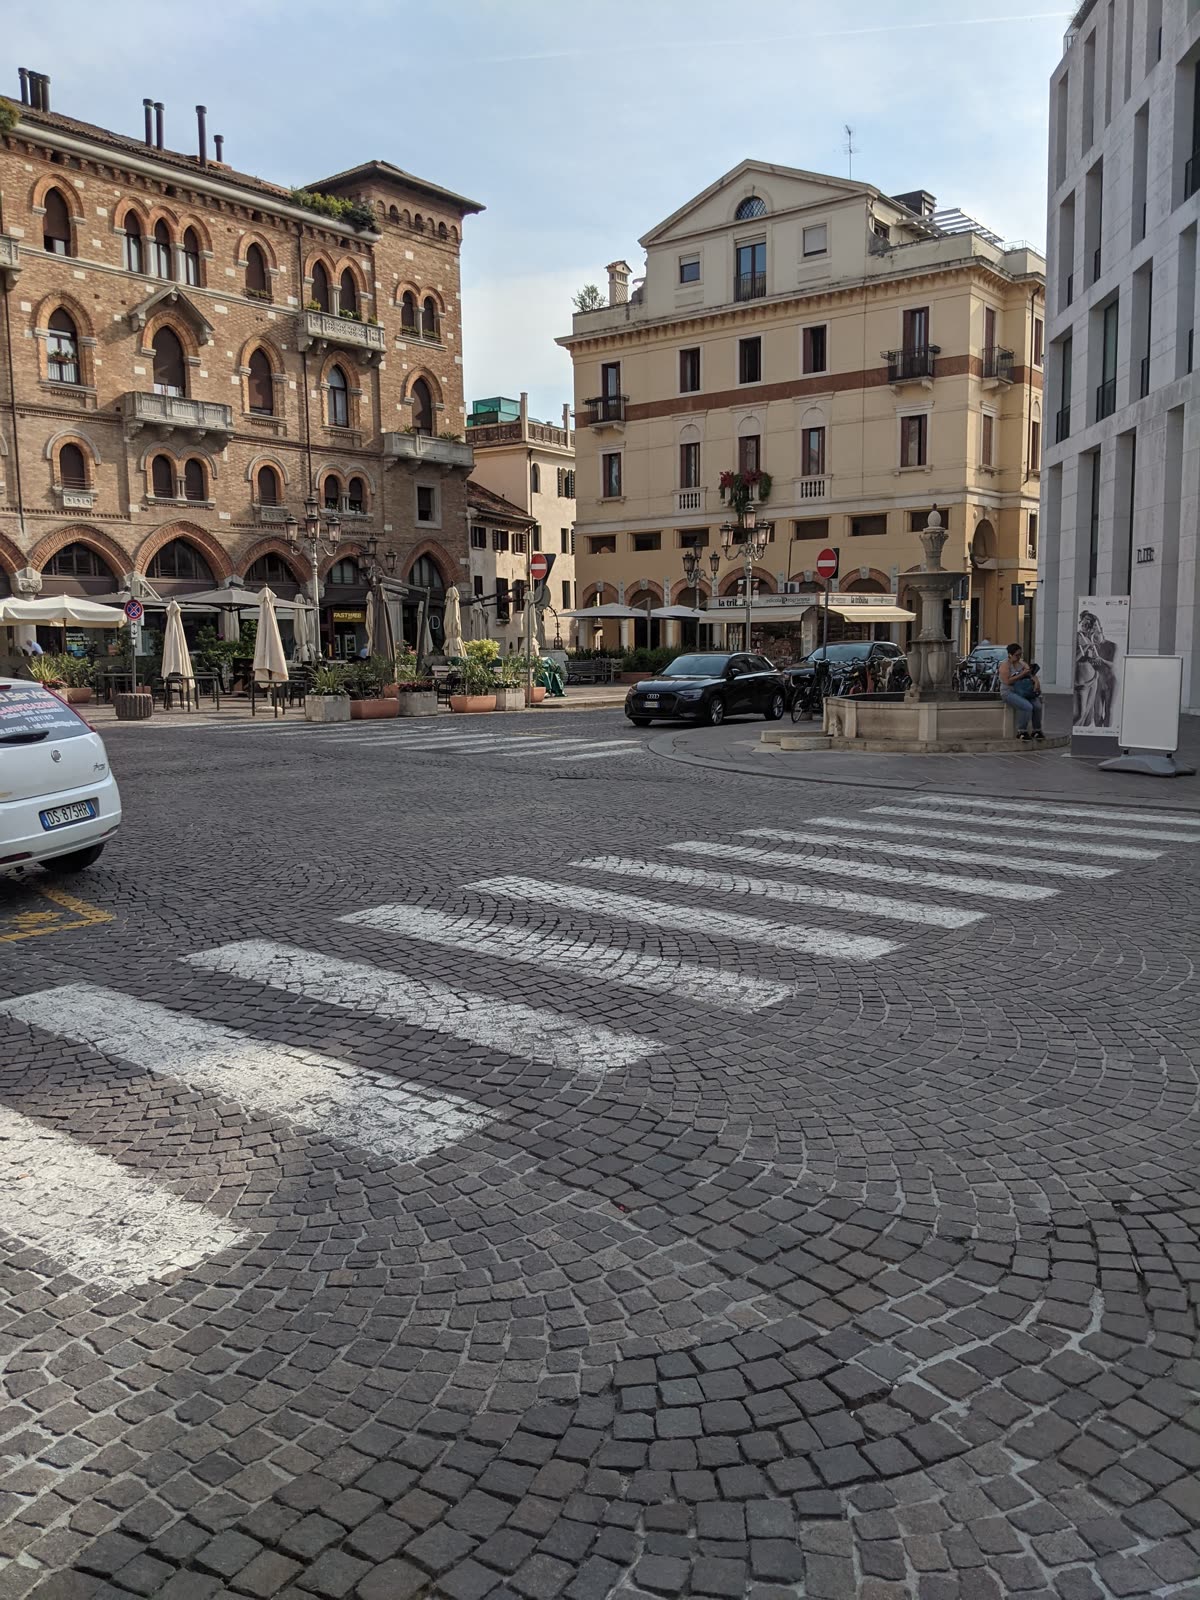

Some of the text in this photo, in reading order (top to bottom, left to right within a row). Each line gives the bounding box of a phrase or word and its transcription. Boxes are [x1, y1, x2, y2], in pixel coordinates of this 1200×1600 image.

[719, 599, 726, 607] la
[46, 802, 90, 825] DS 875HR
